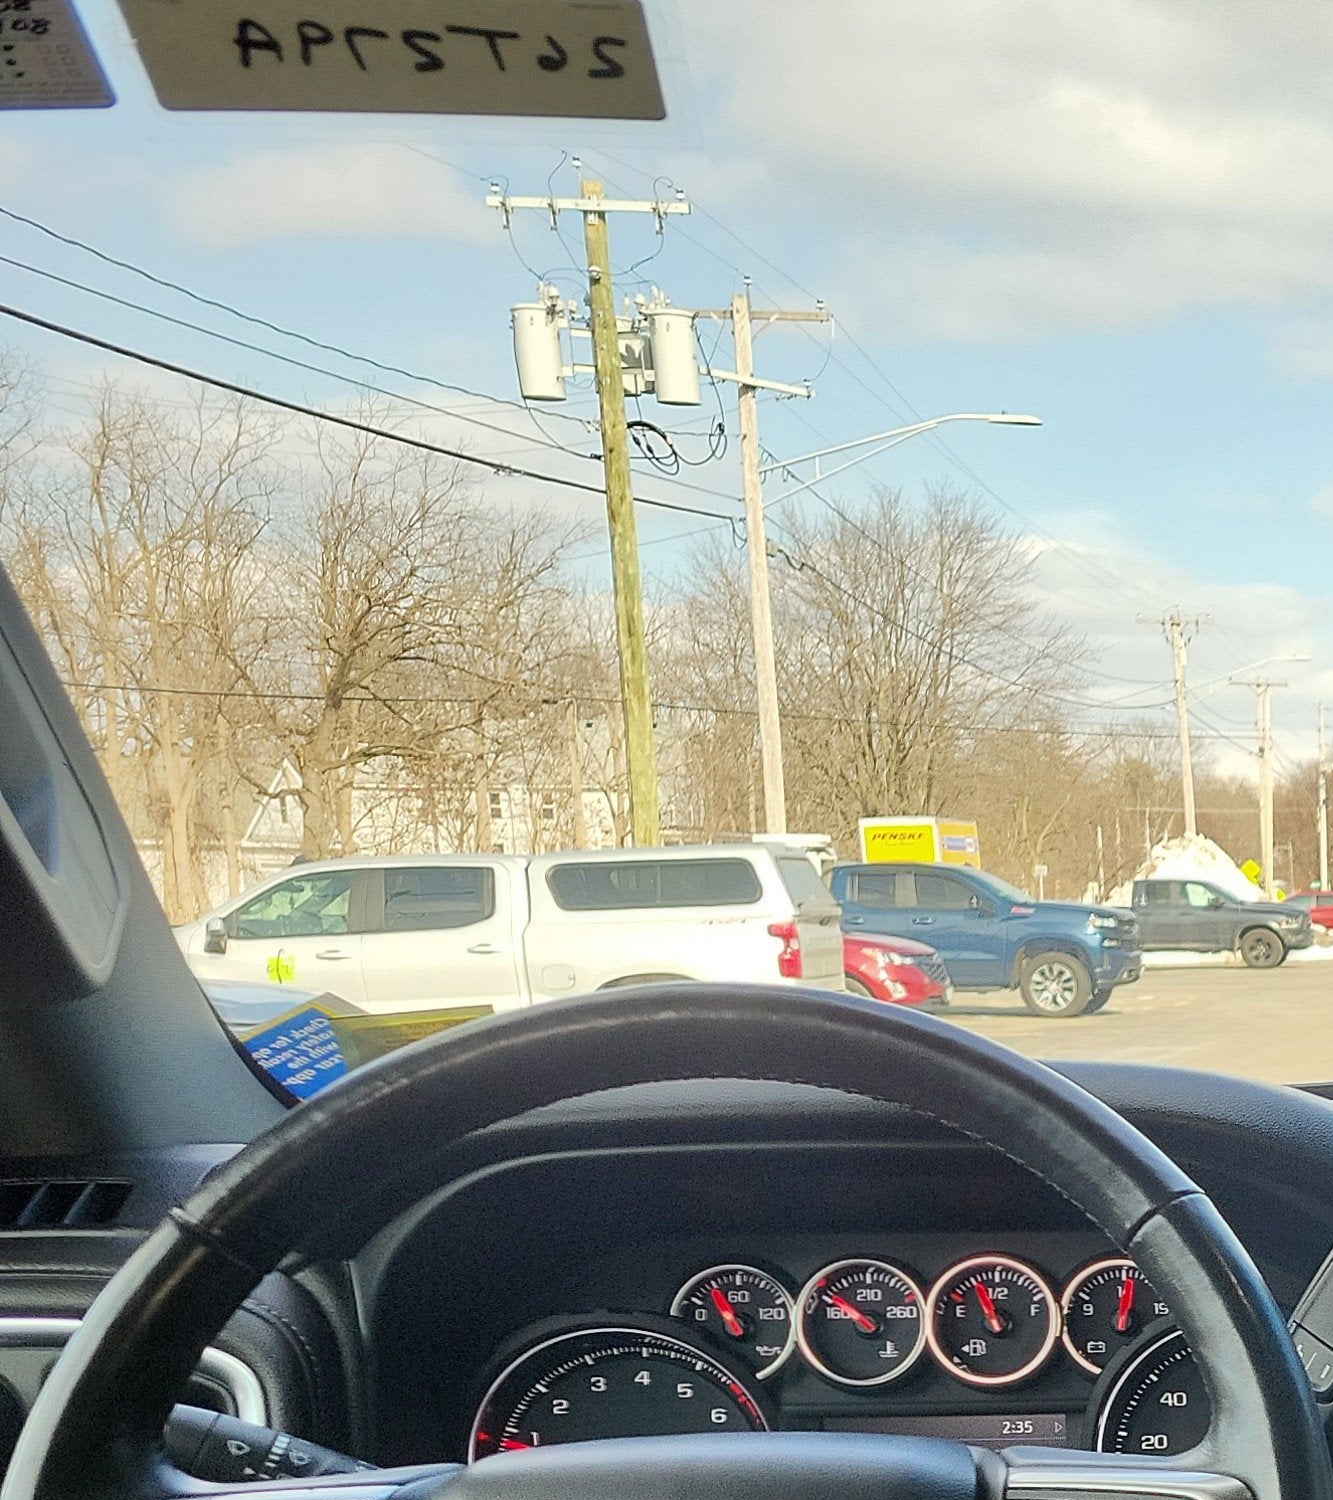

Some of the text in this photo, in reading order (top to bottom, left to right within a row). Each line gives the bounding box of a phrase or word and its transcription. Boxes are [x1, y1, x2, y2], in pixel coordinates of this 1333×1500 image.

[728, 1290, 750, 1303] 60
[856, 1289, 883, 1301] 210
[758, 1307, 786, 1320] 120
[886, 1306, 918, 1319] 260
[955, 1305, 966, 1318] E
[1030, 1304, 1040, 1317] F
[1083, 1303, 1094, 1316] 9
[590, 1376, 608, 1392] 3
[634, 1370, 651, 1386] 4
[676, 1383, 695, 1399] 5
[552, 1398, 570, 1415] 2
[1159, 1391, 1188, 1408] 40
[710, 1407, 728, 1424] 6
[1001, 1420, 1034, 1435] 2:35
[1140, 1434, 1169, 1451] 20
